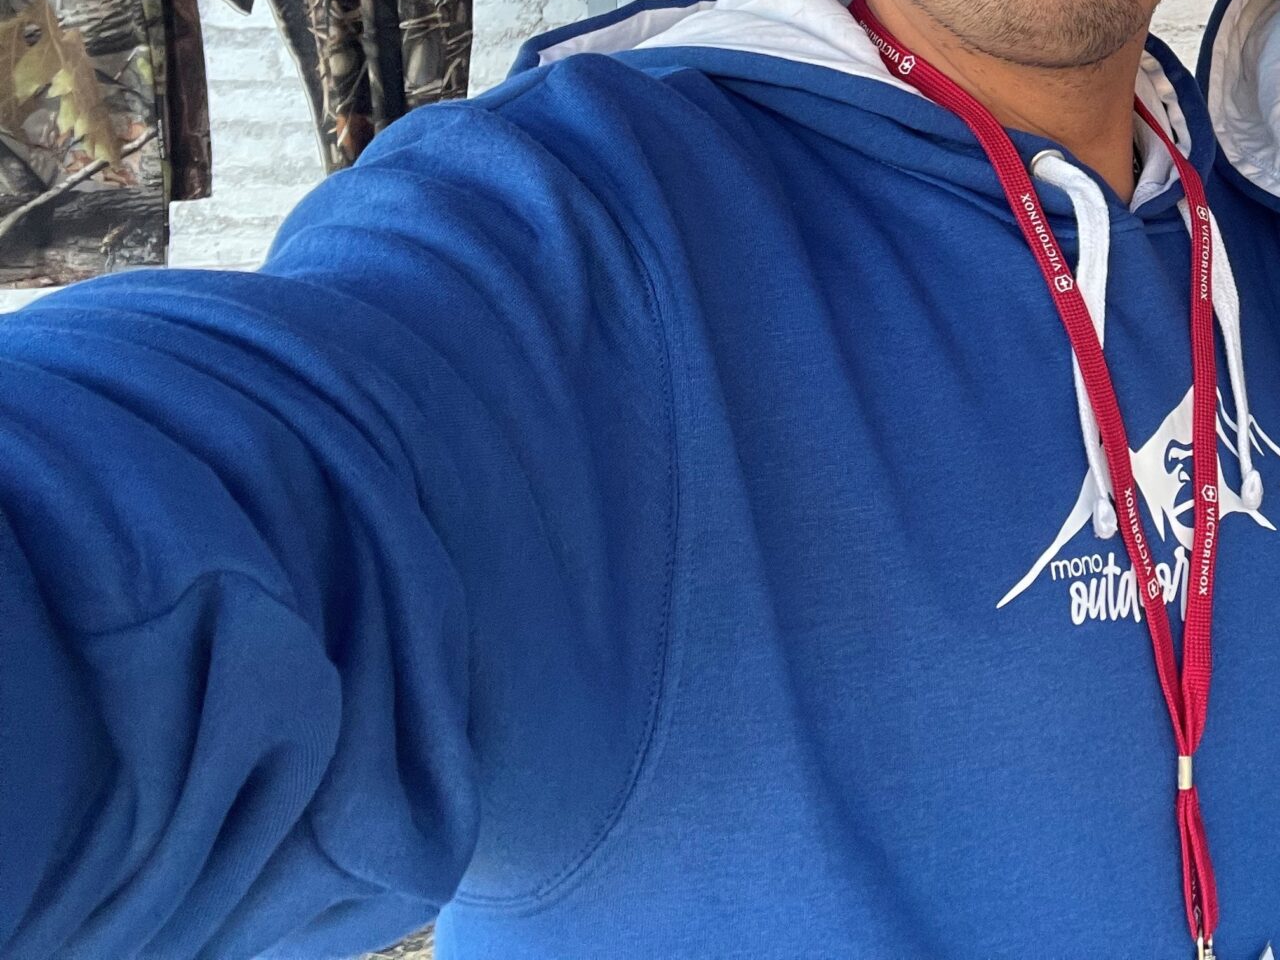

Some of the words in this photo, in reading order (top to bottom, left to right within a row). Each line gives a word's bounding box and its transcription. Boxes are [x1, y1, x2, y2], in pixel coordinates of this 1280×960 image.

[1020, 192, 1062, 272] VICTORINOX
[1199, 224, 1210, 301] VICTORINOX
[1050, 553, 1103, 581] mono
[1124, 487, 1152, 577] VICTORINOX
[1198, 507, 1215, 596] VICTORINOX
